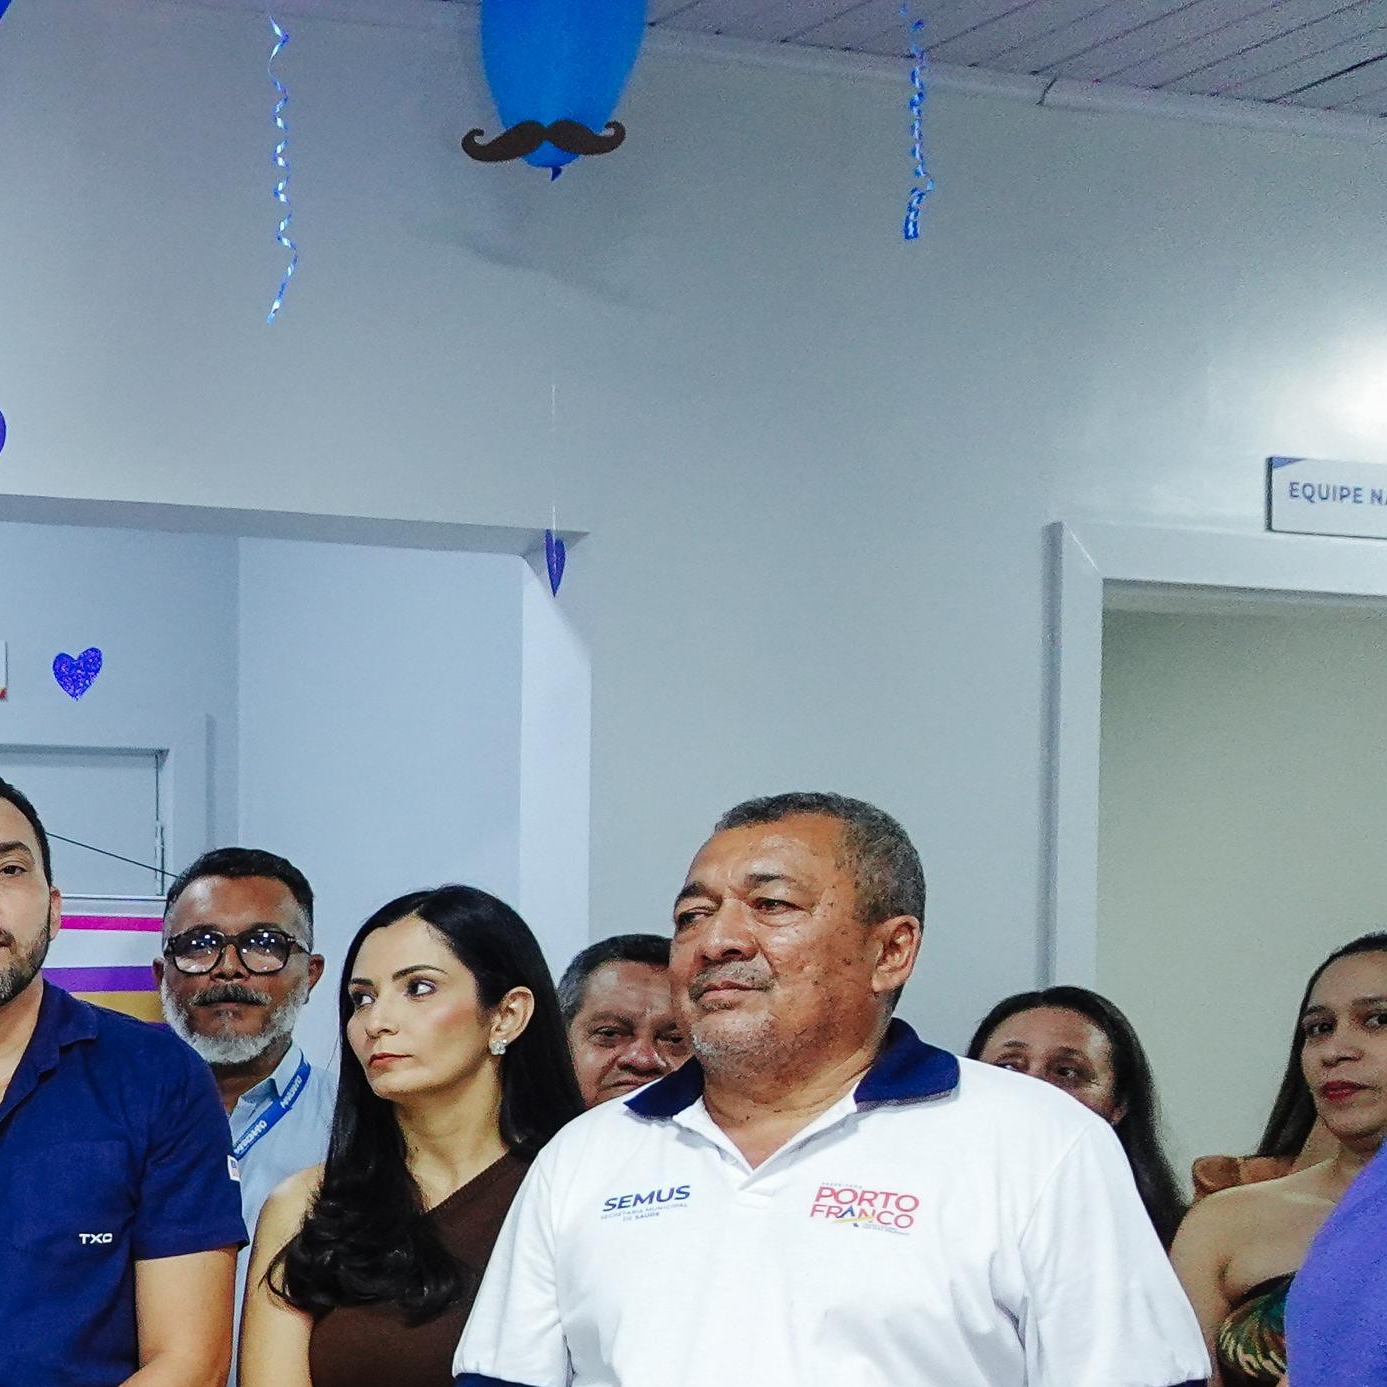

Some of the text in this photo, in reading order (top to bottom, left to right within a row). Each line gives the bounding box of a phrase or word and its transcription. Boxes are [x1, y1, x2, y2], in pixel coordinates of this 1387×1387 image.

[1289, 481, 1364, 504] EQUIPE
[602, 1184, 691, 1212] SEMUS
[814, 1186, 920, 1213] PORTO
[809, 1204, 914, 1229] FRANCO
